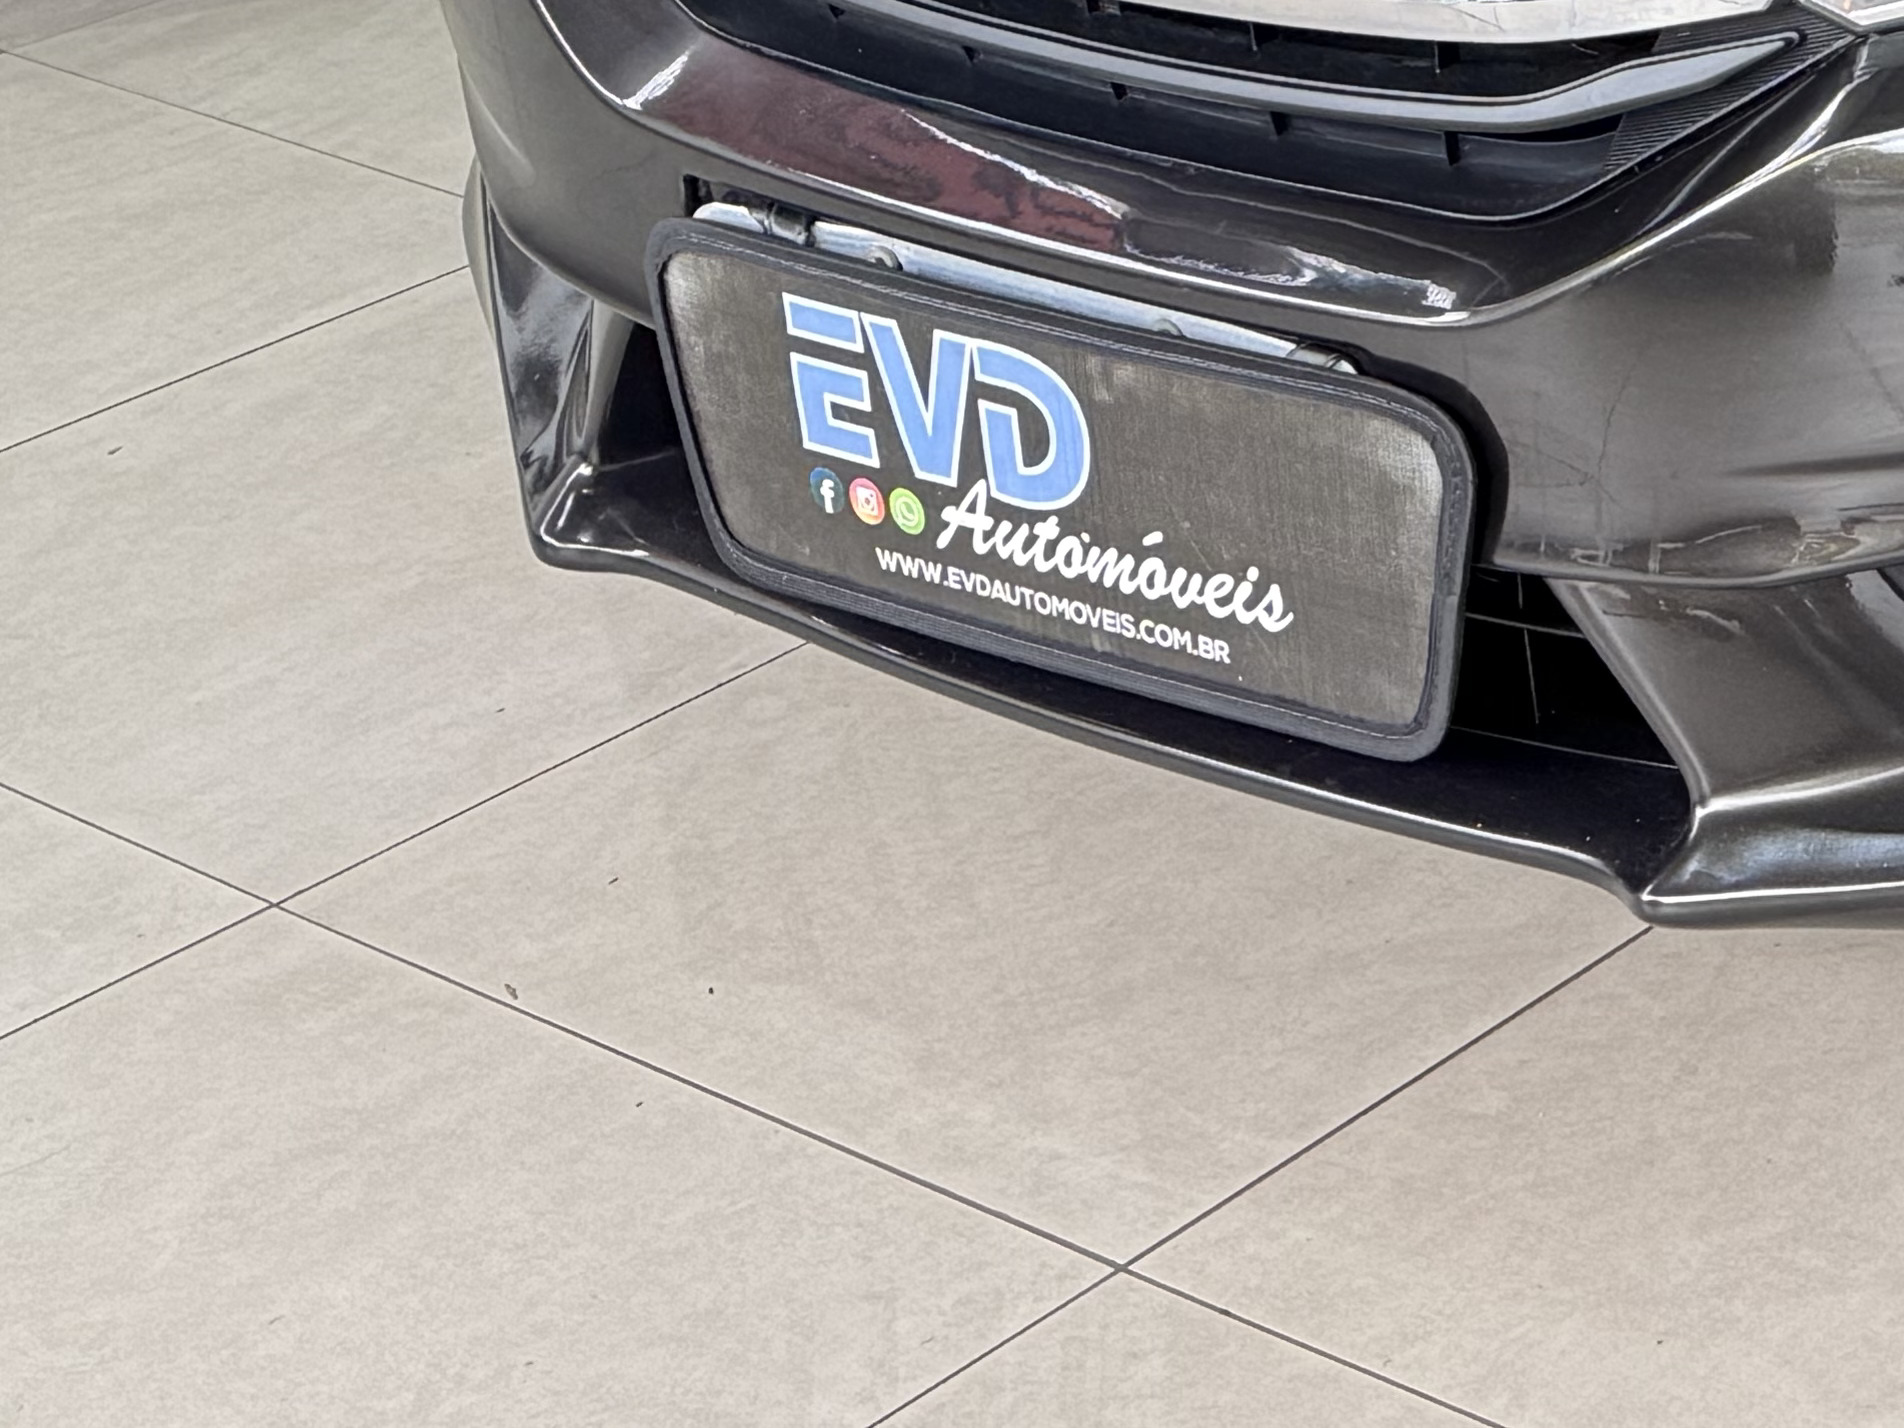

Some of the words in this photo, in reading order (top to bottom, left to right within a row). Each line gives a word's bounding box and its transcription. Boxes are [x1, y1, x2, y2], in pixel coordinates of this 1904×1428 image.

[781, 290, 1092, 511] EVD
[875, 545, 1231, 665] WWW.EVDAUTOMOVEIS.COM.BR
[936, 478, 1294, 633] Automóveis
